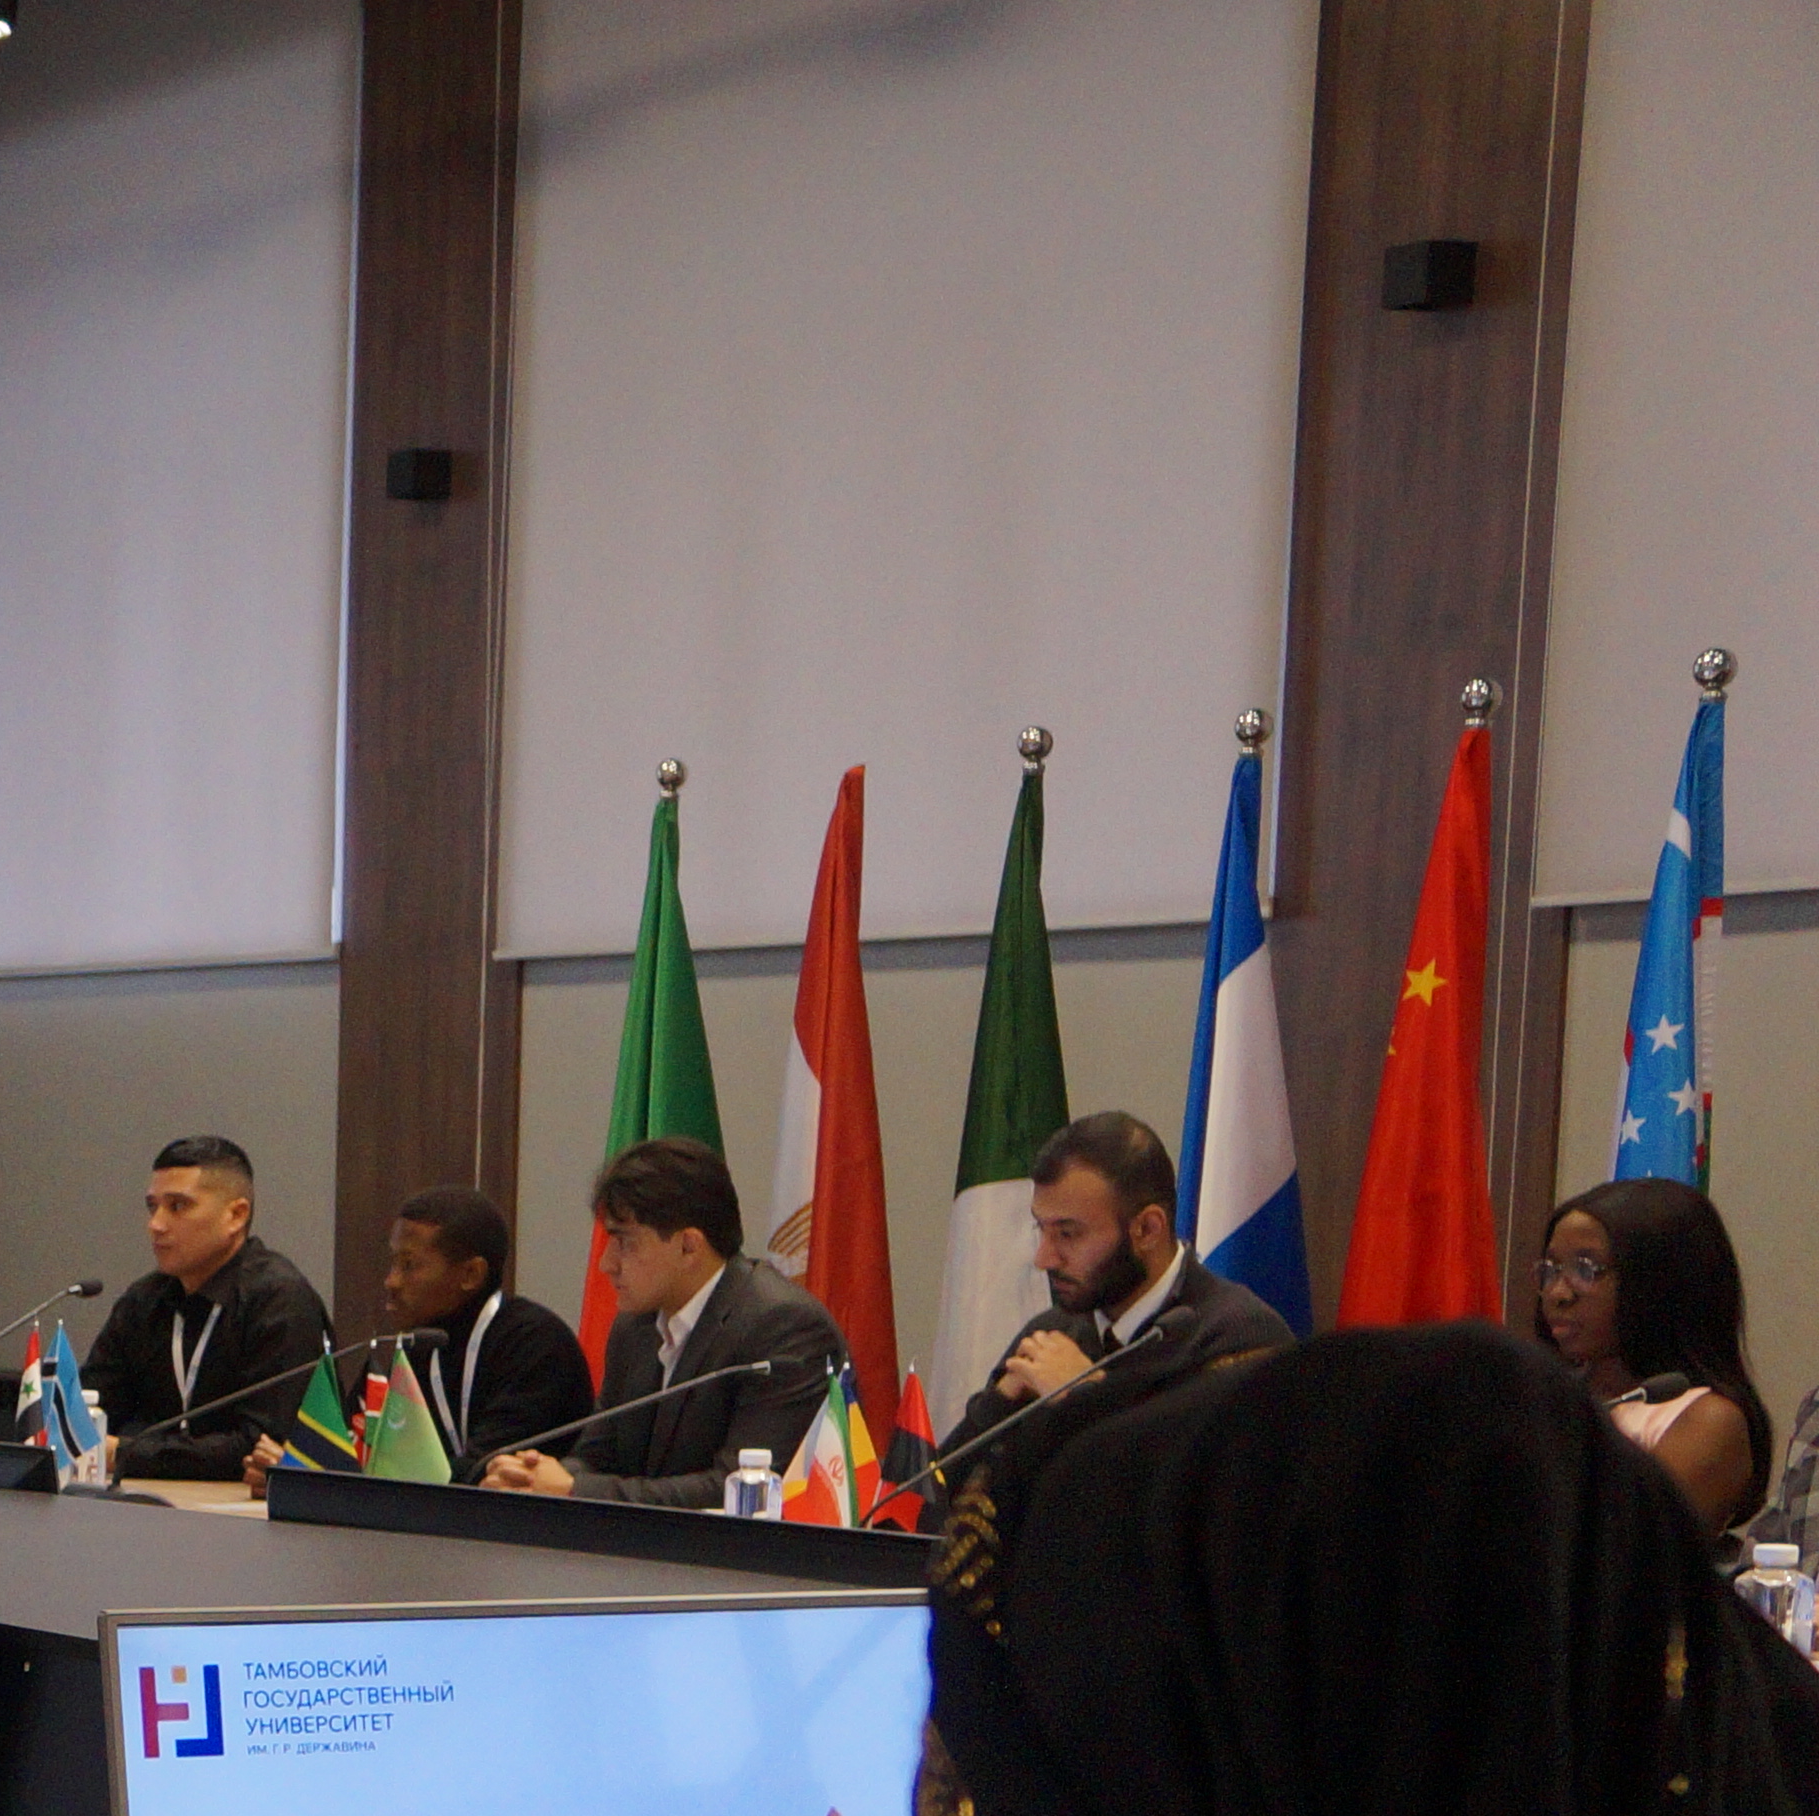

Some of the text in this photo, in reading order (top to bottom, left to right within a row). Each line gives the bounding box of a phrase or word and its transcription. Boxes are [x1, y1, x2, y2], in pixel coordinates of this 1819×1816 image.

[243, 1654, 388, 1681] ТАМБОВСКИЙ
[243, 1680, 455, 1710] ГОСУДАРСТВЕННЫЙ
[245, 1713, 394, 1736] УНИВЕРСИТЕТ
[296, 1740, 376, 1755] ДЕРЖАВИНА
